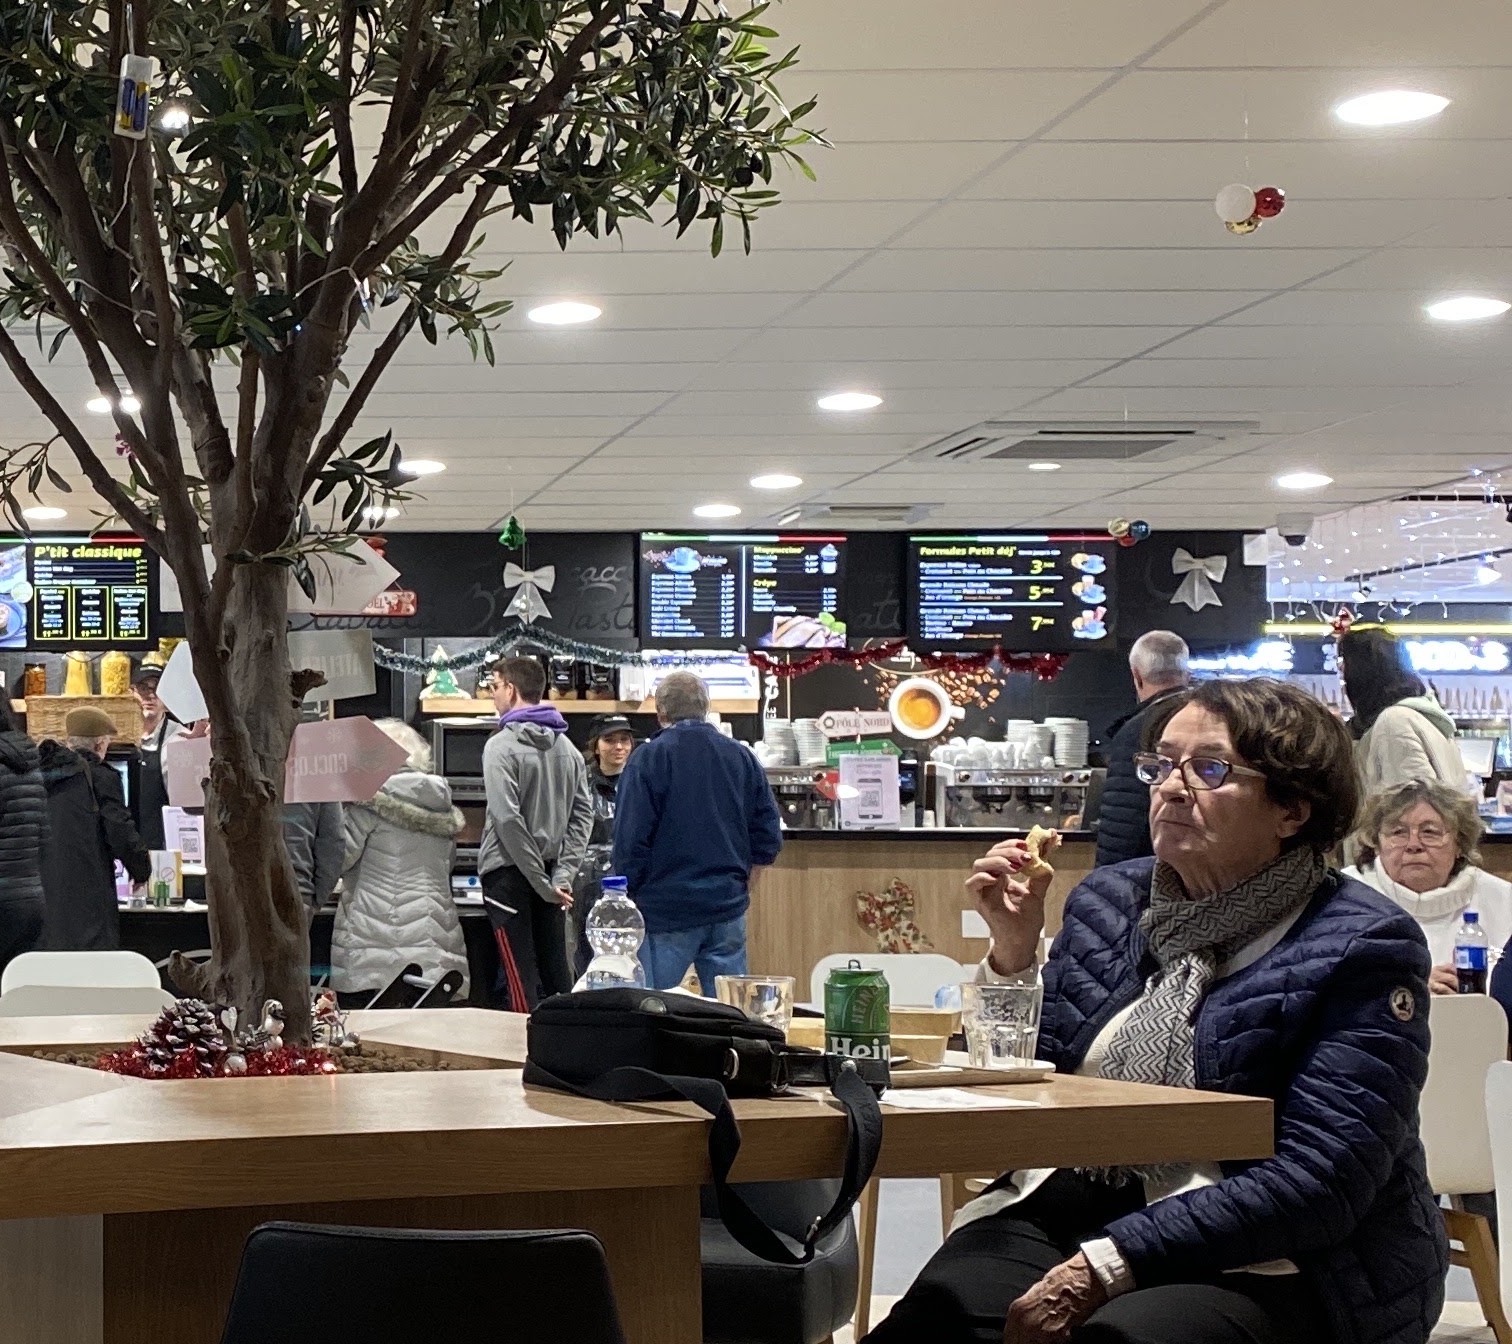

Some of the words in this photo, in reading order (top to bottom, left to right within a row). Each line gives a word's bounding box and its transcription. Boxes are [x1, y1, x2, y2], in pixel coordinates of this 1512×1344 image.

[34, 545, 69, 558] P'tit
[71, 544, 143, 561] classique
[919, 546, 967, 556] Formules
[968, 545, 995, 556] Petit
